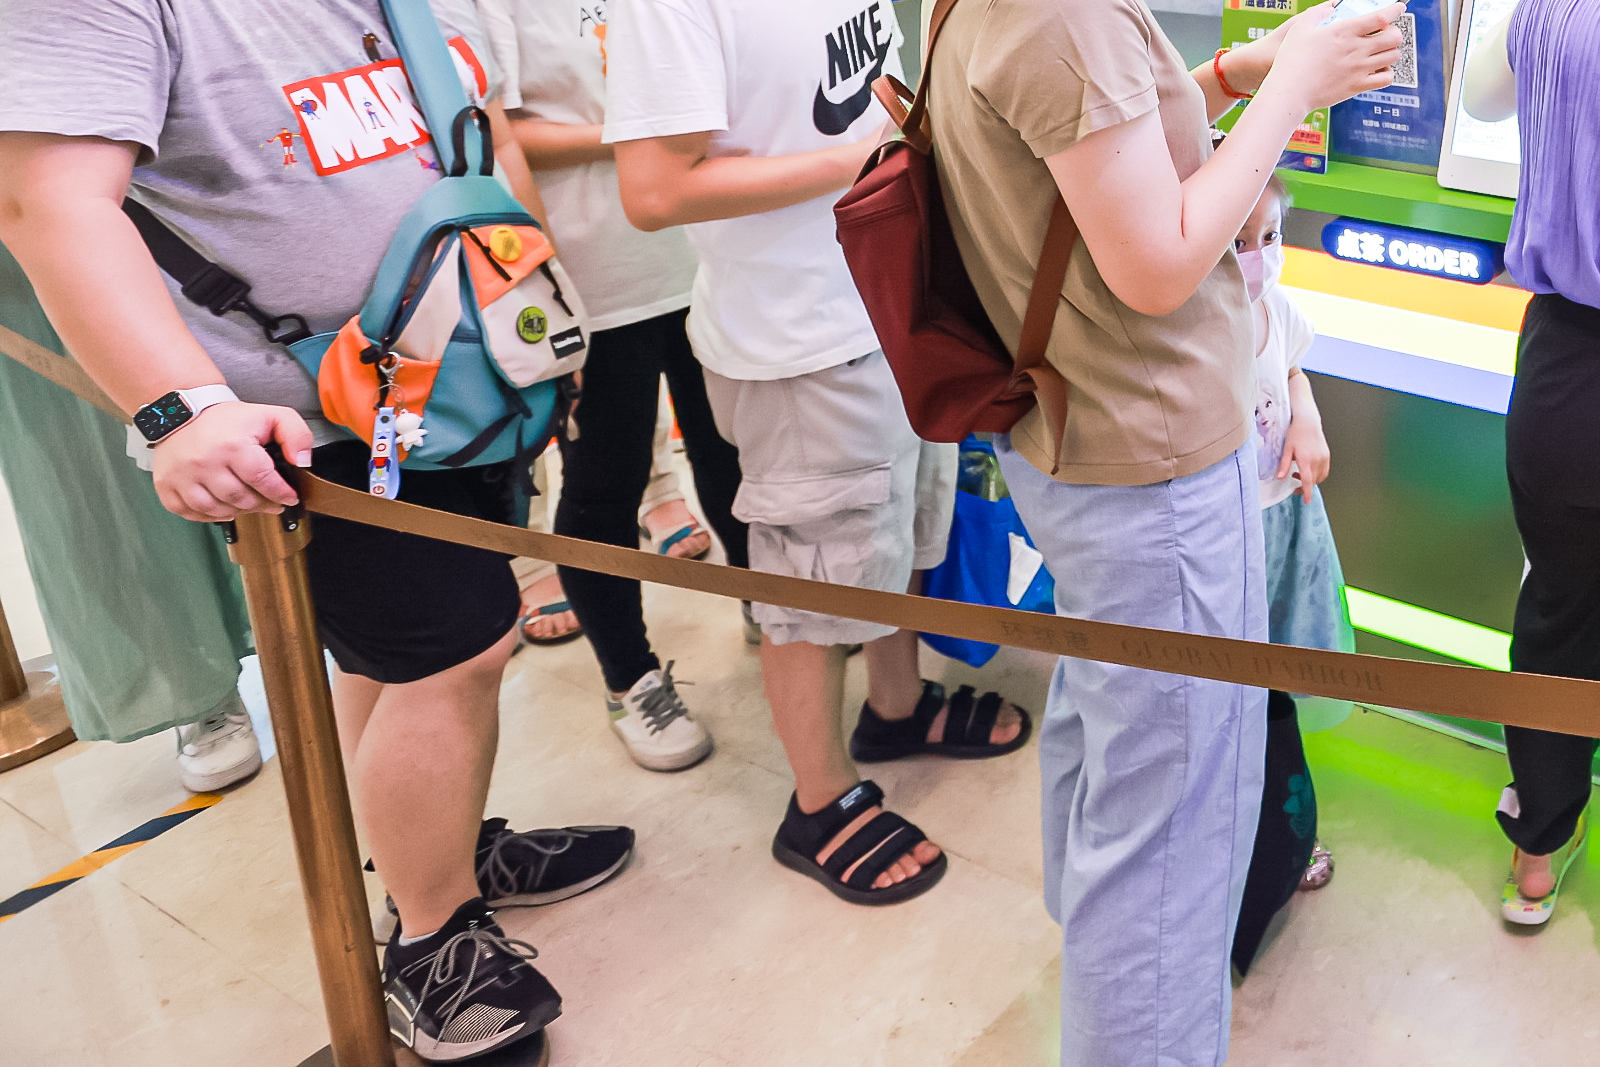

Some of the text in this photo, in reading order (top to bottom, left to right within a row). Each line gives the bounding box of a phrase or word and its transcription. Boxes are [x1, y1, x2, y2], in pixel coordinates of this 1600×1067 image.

[826, 0, 882, 90] NIKE
[1337, 230, 1480, 279] 点茶 ORDER
[1252, 656, 1383, 691] HARBOR
